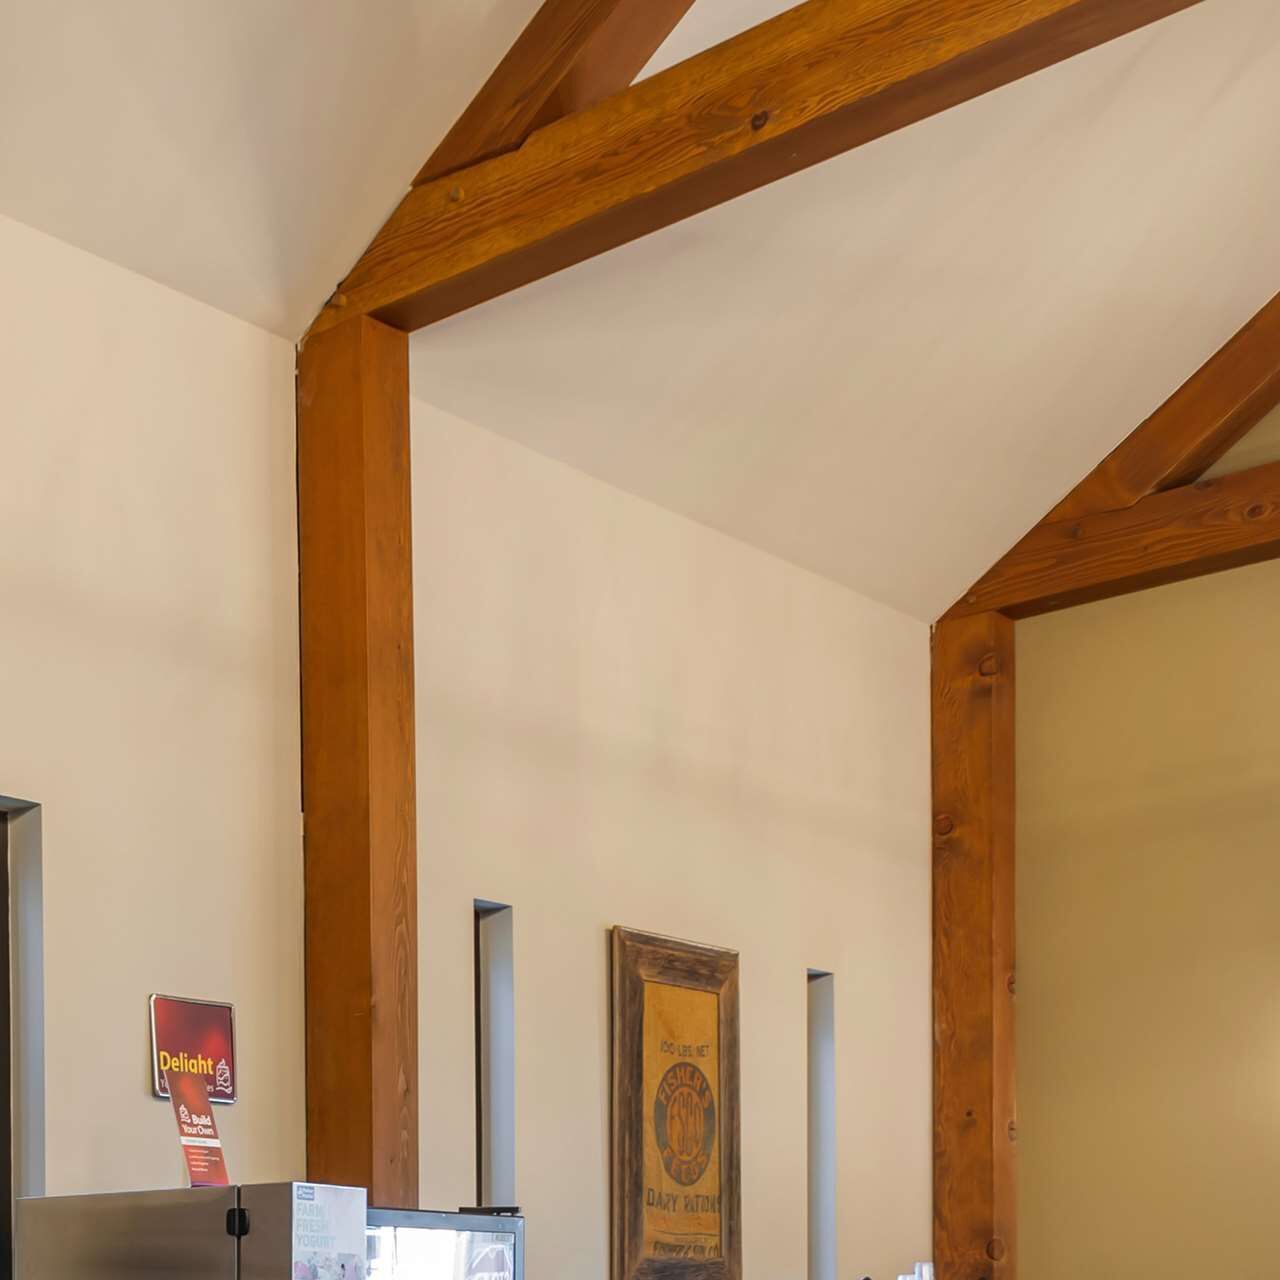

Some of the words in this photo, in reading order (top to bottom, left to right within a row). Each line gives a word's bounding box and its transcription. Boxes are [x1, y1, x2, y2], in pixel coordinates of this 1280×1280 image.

[160, 1051, 214, 1075] Delight
[192, 1114, 211, 1126] Build
[182, 1124, 198, 1135] Your
[198, 1125, 214, 1136] Own
